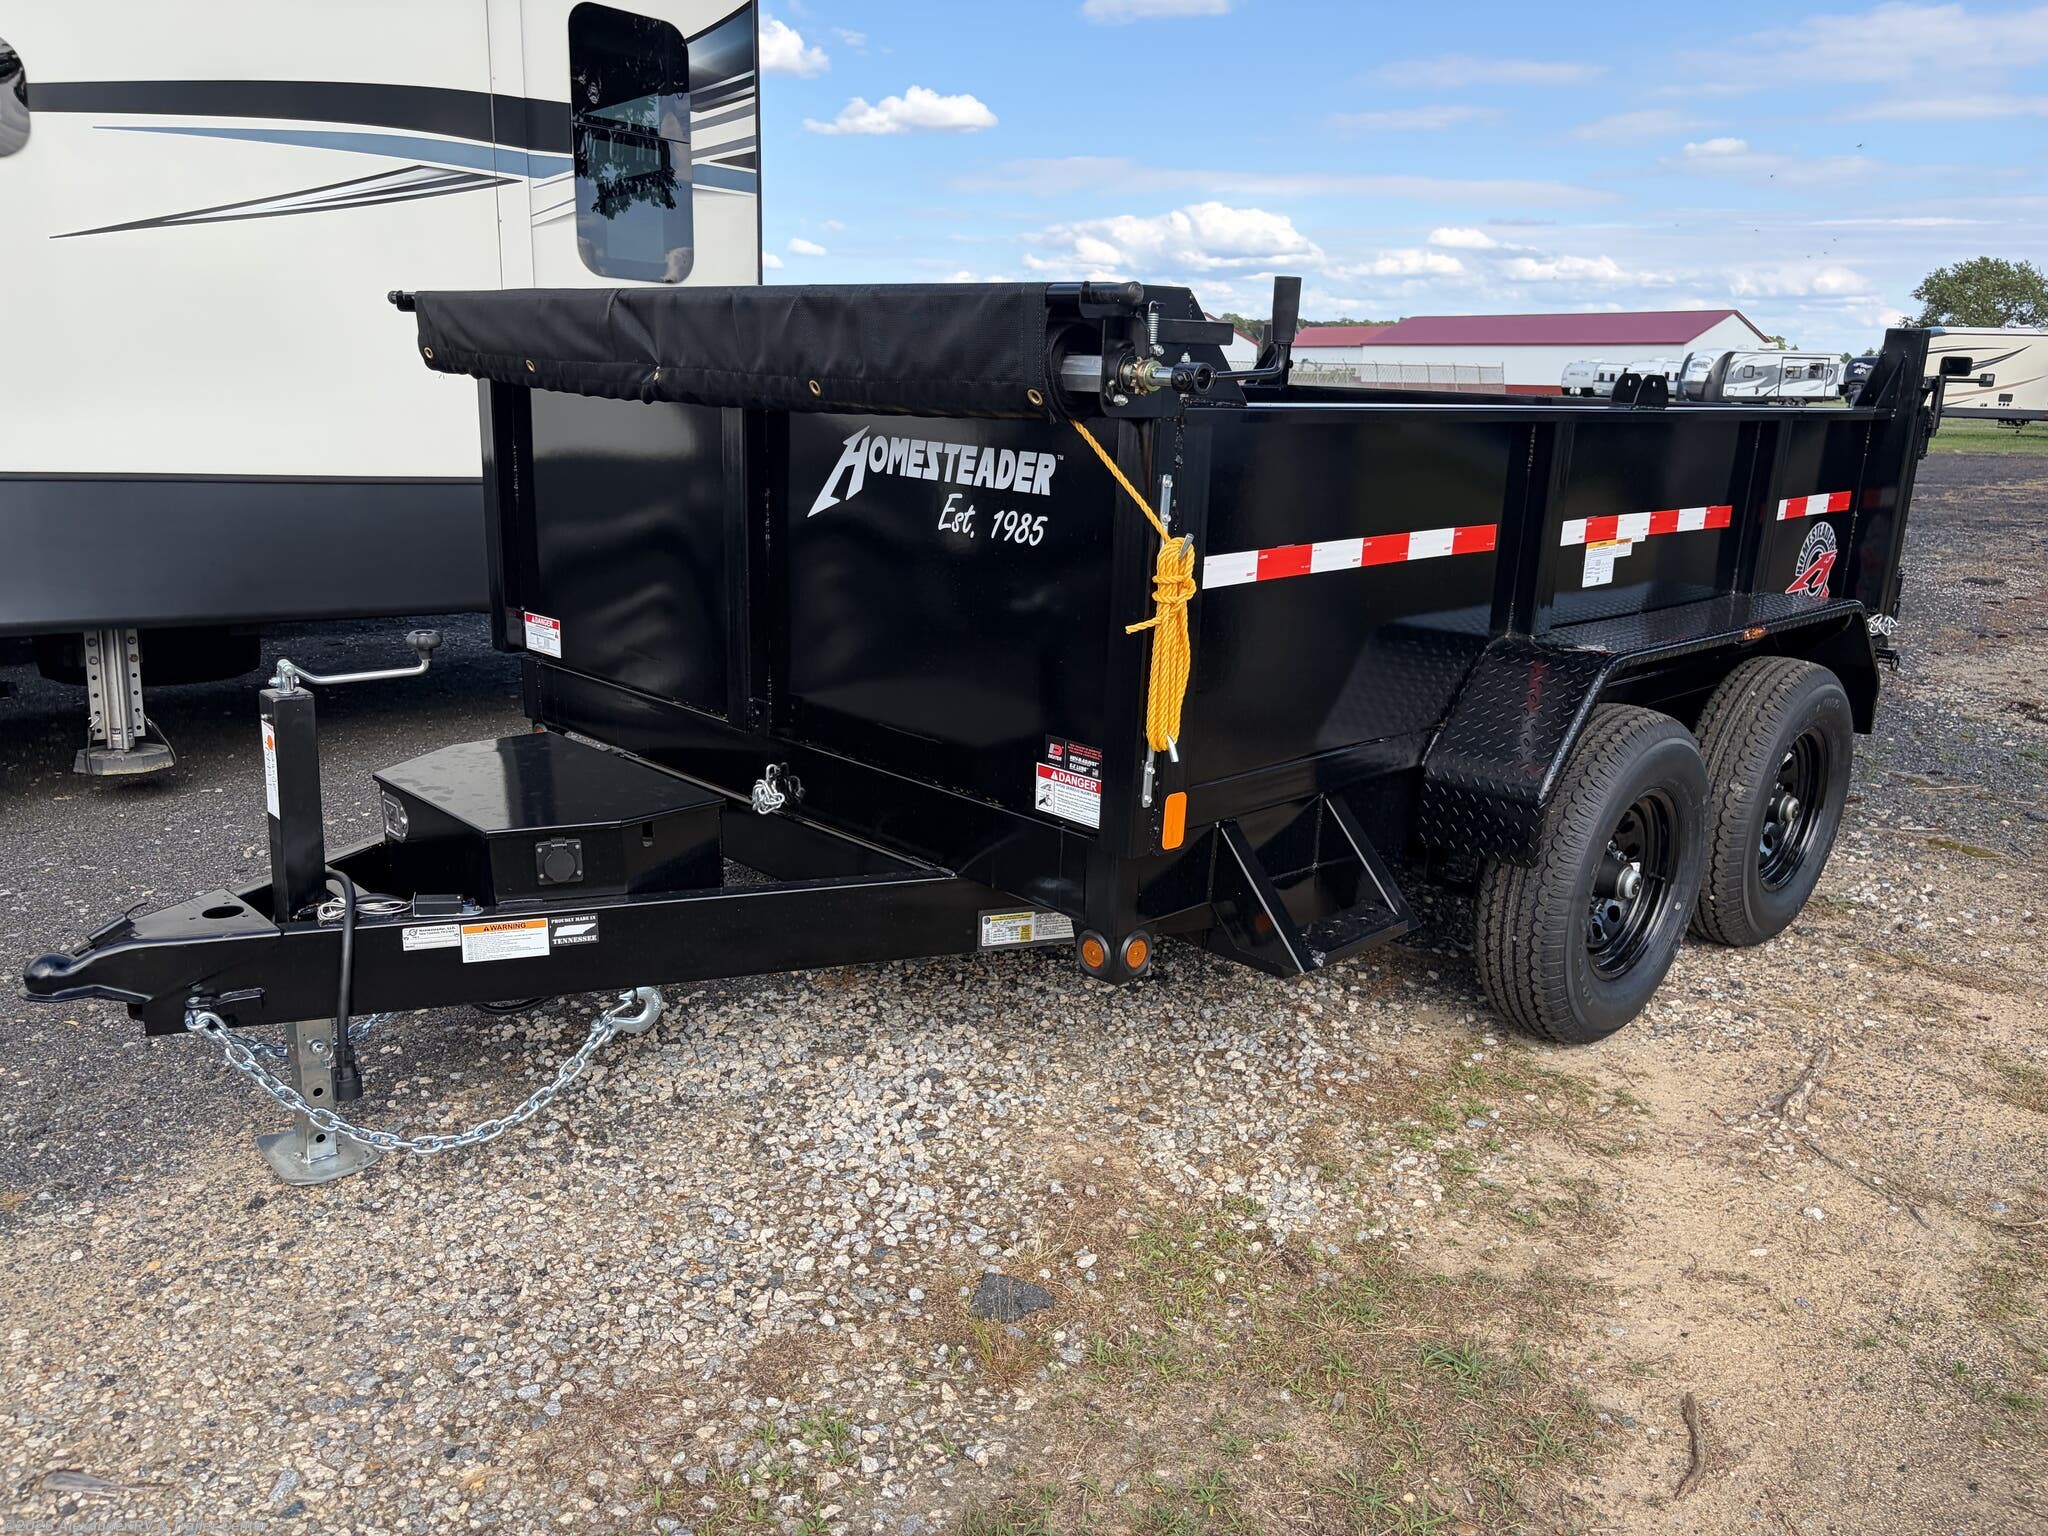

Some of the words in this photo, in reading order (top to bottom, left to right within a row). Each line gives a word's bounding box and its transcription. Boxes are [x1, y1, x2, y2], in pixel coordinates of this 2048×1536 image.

[938, 493, 976, 539] Est.
[990, 510, 1048, 546] 1985
[1796, 523, 1836, 575] HOMESTEADER
[1058, 773, 1097, 792] DANGER
[490, 922, 526, 931] WARNING
[552, 935, 597, 945] TENNESSEE
